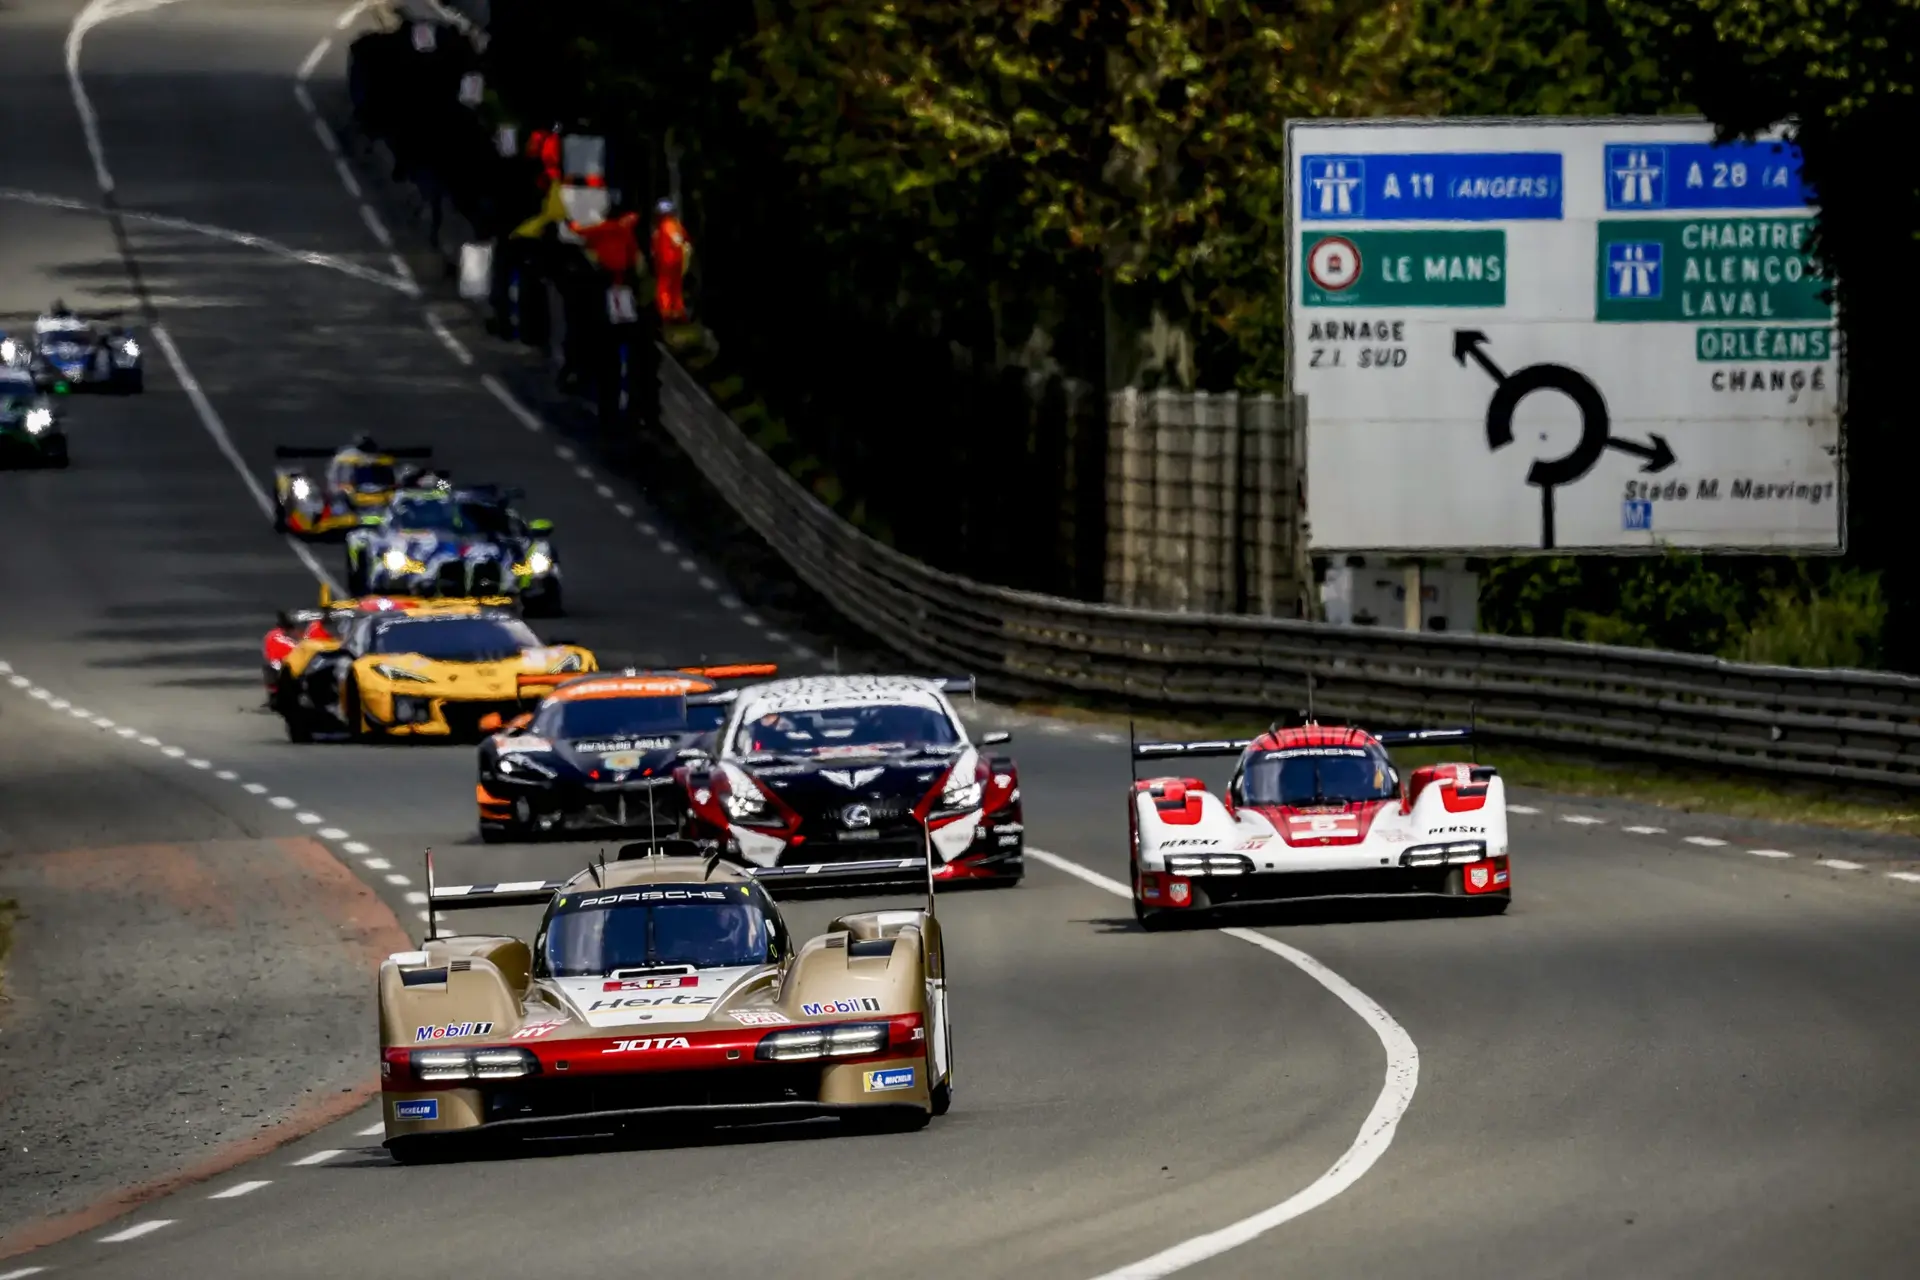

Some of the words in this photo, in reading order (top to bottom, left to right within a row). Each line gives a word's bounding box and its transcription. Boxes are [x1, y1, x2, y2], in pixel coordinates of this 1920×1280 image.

[1383, 173, 1401, 199] A
[1409, 173, 1435, 199] 11
[1450, 176, 1558, 200] (ANGERS)
[1686, 162, 1703, 189] A
[1712, 162, 1748, 189] 28
[1682, 223, 1816, 250] CHARTRE
[1381, 256, 1413, 283] LE
[1424, 255, 1501, 283] MANS
[1682, 290, 1774, 317] LAVAL
[1308, 320, 1406, 342] ARNAGE
[1701, 328, 1826, 358] ORLÉANS
[1357, 347, 1408, 369] SUD
[1624, 480, 1689, 500] Stade
[1428, 825, 1487, 836] PENSKE
[579, 891, 726, 908] PORSCHE
[588, 996, 718, 1011] Hertz
[802, 999, 860, 1016] Mobil
[415, 1023, 472, 1042] Mobil
[602, 1037, 691, 1054] JOTA
